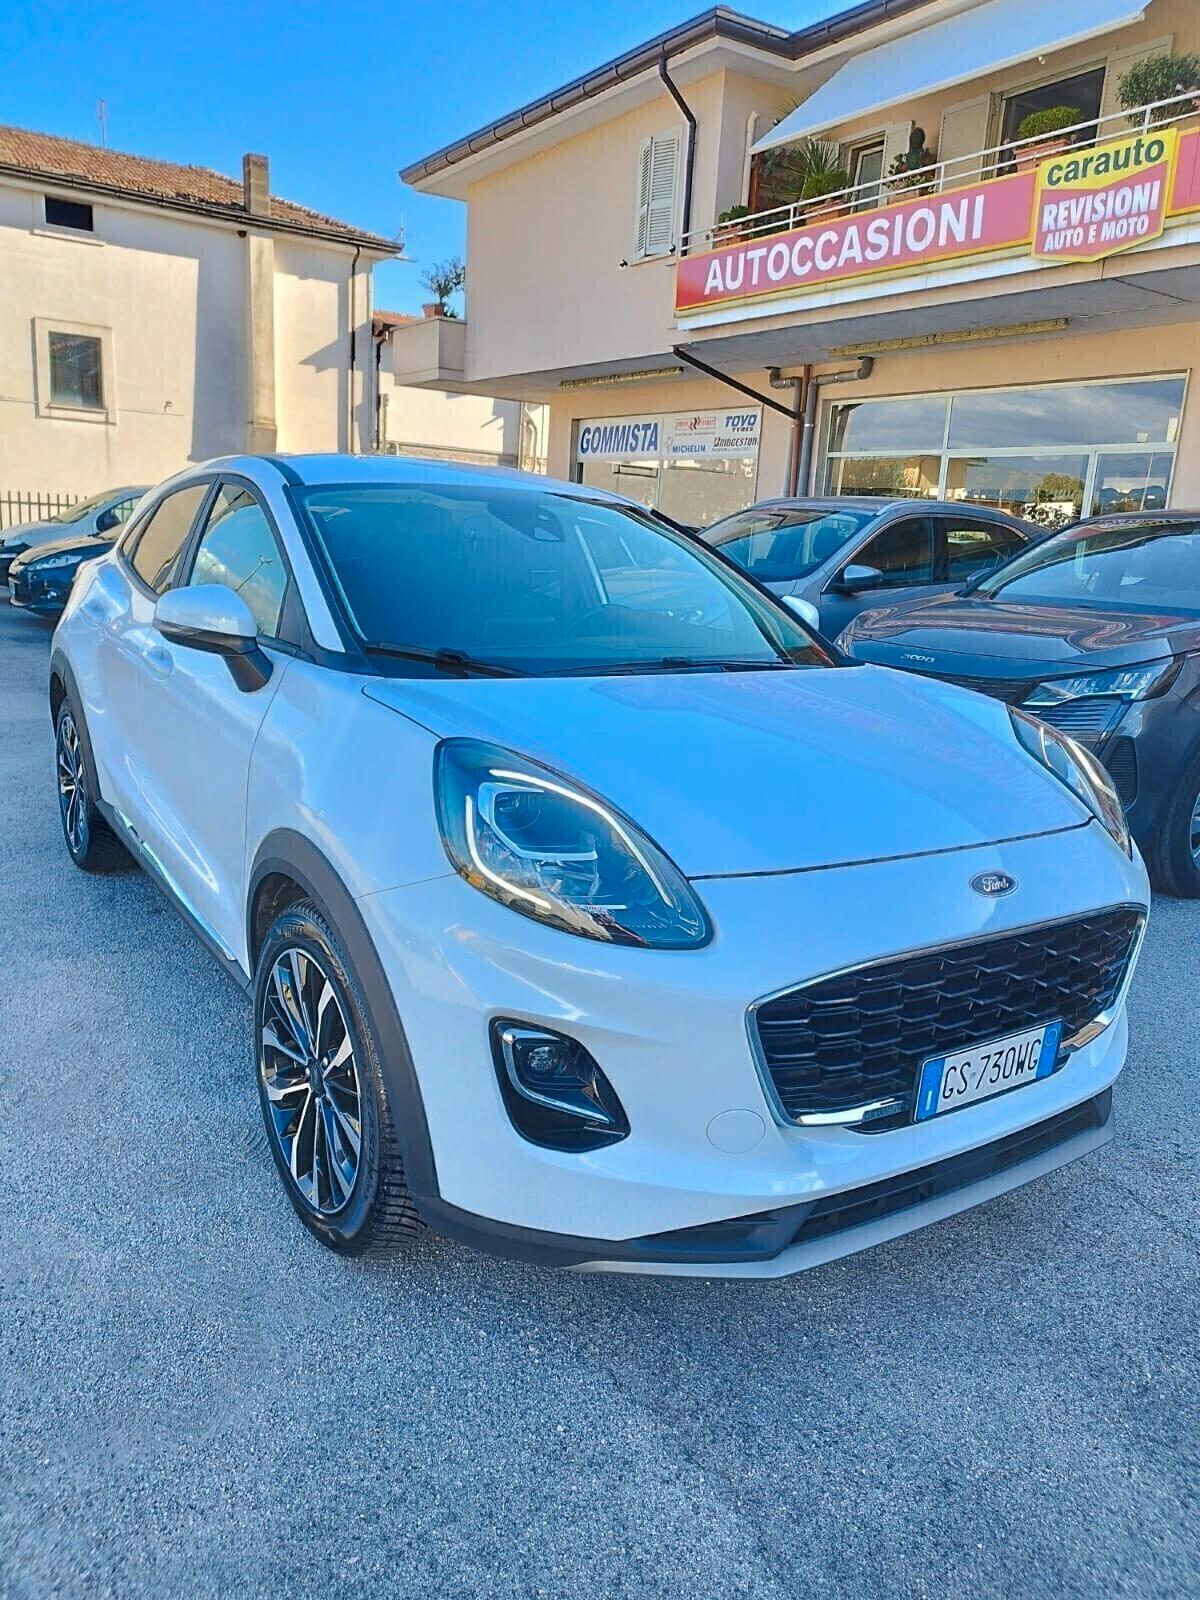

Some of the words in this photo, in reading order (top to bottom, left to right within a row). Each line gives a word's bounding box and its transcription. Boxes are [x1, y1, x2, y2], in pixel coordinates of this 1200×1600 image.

[1047, 138, 1165, 186] carauto
[1041, 180, 1161, 232] REVISIONI
[703, 194, 985, 296] AUTOCCASIONI
[1043, 227, 1084, 252] AUTO
[1087, 224, 1097, 244] E
[1100, 214, 1150, 242] MOTO
[580, 423, 659, 454] GOMMISTA
[672, 444, 706, 454] MICHELIN
[982, 876, 1009, 892] Ford
[942, 1061, 971, 1100] GS
[975, 1038, 1042, 1090] 730WG
